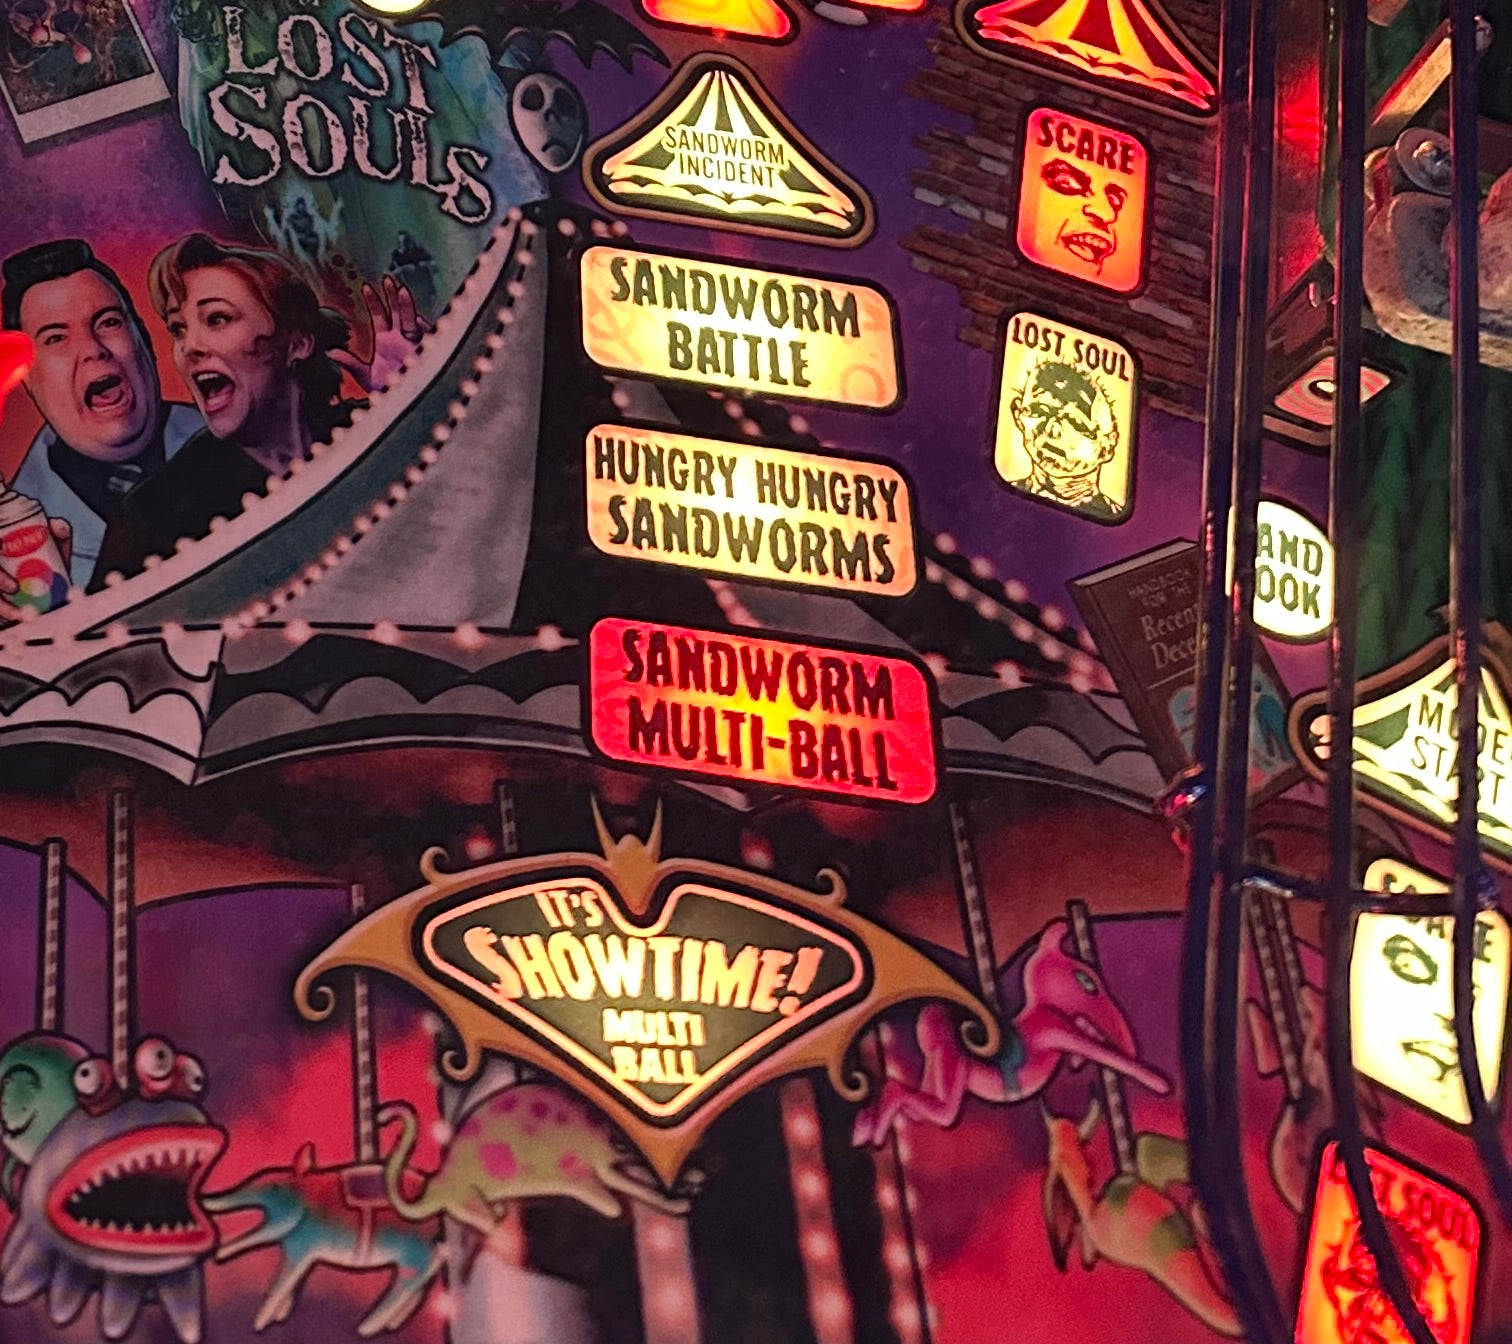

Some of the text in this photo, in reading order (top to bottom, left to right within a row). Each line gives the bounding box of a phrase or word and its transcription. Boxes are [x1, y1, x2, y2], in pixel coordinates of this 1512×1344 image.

[221, 5, 440, 116] LOST
[206, 79, 494, 226] SOULS
[664, 124, 786, 166] SANDWORM
[677, 150, 778, 190] INCIDENT
[1036, 115, 1136, 177] SCARE
[609, 255, 861, 339] SANDWORM
[666, 320, 812, 389] BATTLE
[1010, 316, 1131, 383] LOST SOUL
[593, 434, 899, 524] HUNGRY HUNGRY
[607, 494, 896, 585] SANDWORMS
[621, 627, 897, 722] SANDWORM
[625, 696, 900, 792] MULTI-BALL
[534, 888, 603, 929] IT'S
[463, 924, 825, 1016] SHOWTIME!
[602, 1007, 707, 1048] MULTI
[610, 1046, 701, 1085] BALL
